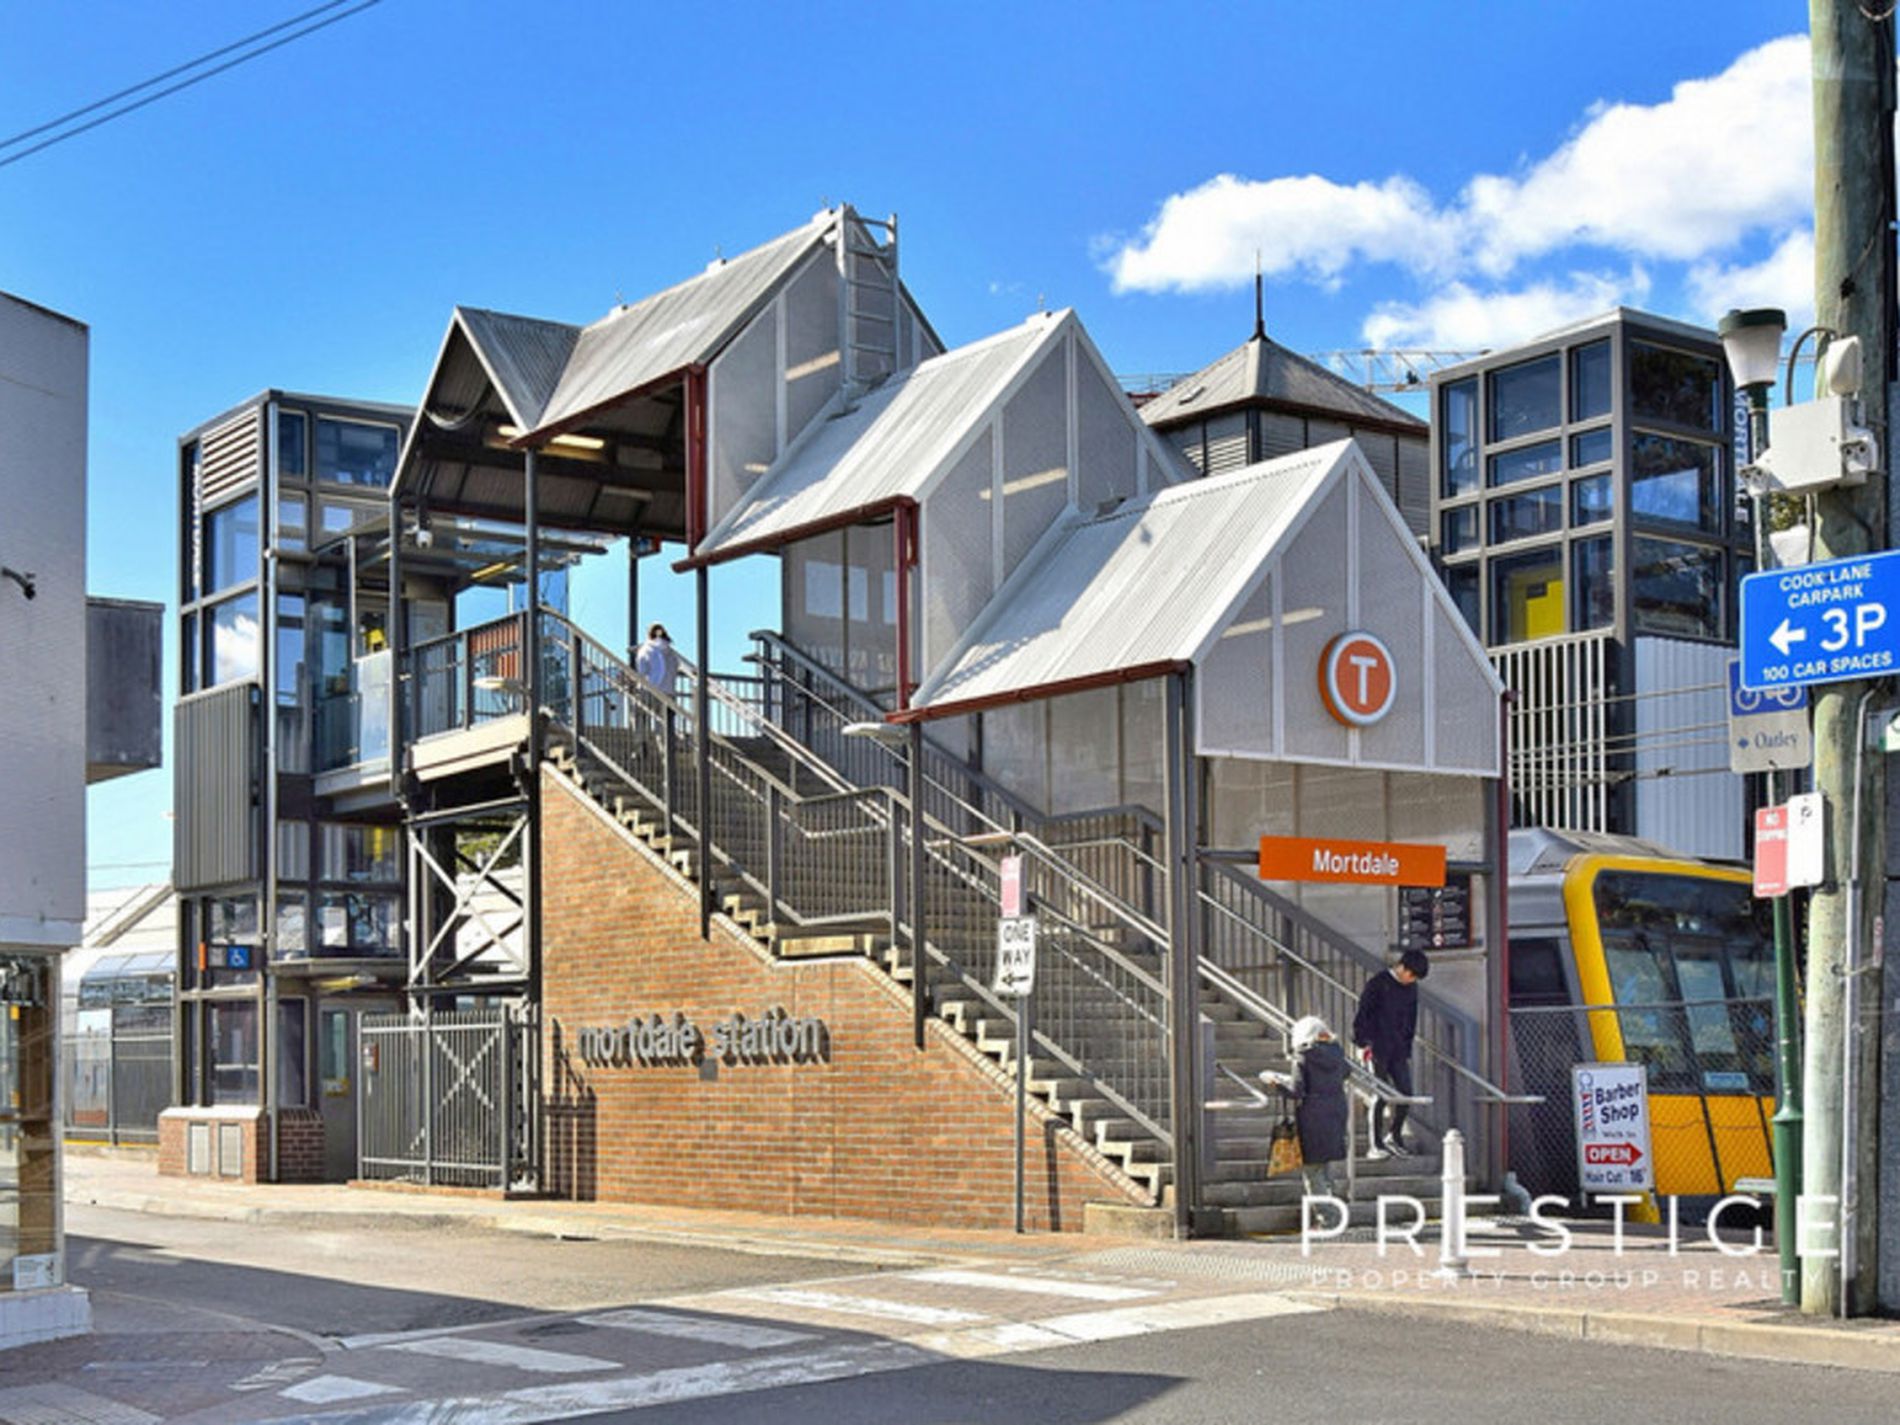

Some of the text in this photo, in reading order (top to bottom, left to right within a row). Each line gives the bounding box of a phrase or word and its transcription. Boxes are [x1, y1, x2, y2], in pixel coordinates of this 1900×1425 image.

[1779, 563, 1872, 591] COOK LANE
[1787, 584, 1864, 609] CARPARK
[1819, 603, 1887, 651] 3P
[1763, 651, 1893, 681] 100 CAR SPACES
[1350, 655, 1378, 705] T
[1754, 730, 1799, 751] Oatley
[1312, 849, 1400, 876] Mortdale
[1003, 923, 1030, 943] ONE
[1002, 951, 1030, 966] WAY
[577, 1008, 824, 1061] mortdale station
[1595, 1083, 1640, 1105] Barber
[1600, 1104, 1640, 1124] Shop
[1589, 1147, 1631, 1162] OPEN
